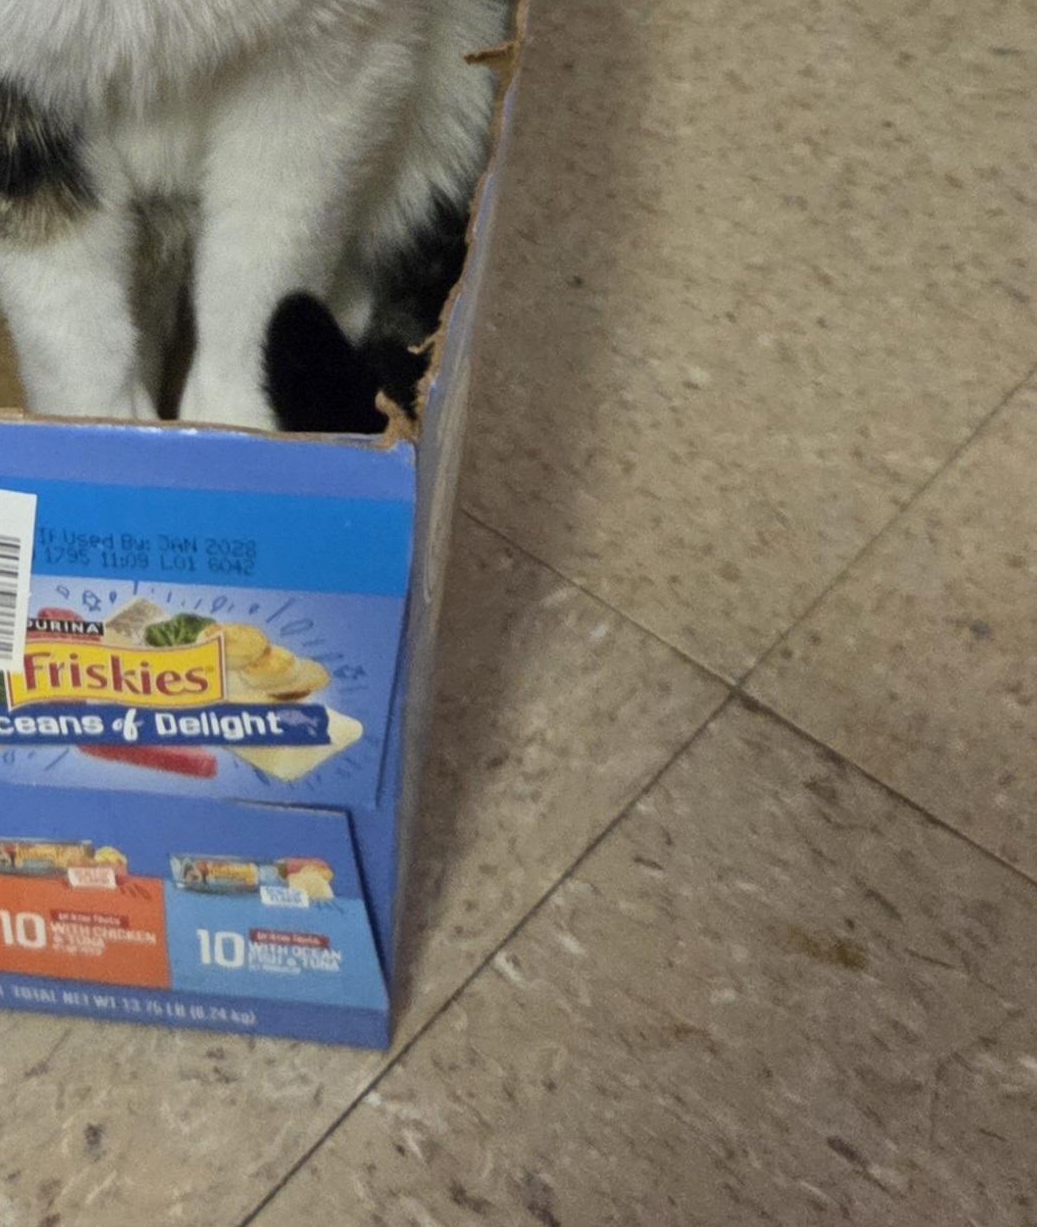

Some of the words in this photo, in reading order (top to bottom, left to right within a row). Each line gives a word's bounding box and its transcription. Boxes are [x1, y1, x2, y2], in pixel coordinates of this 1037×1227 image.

[205, 537, 257, 558] 2028
[24, 651, 209, 695] Friskies
[112, 708, 144, 741] of
[155, 711, 283, 740] Delight
[196, 929, 245, 969] 10
